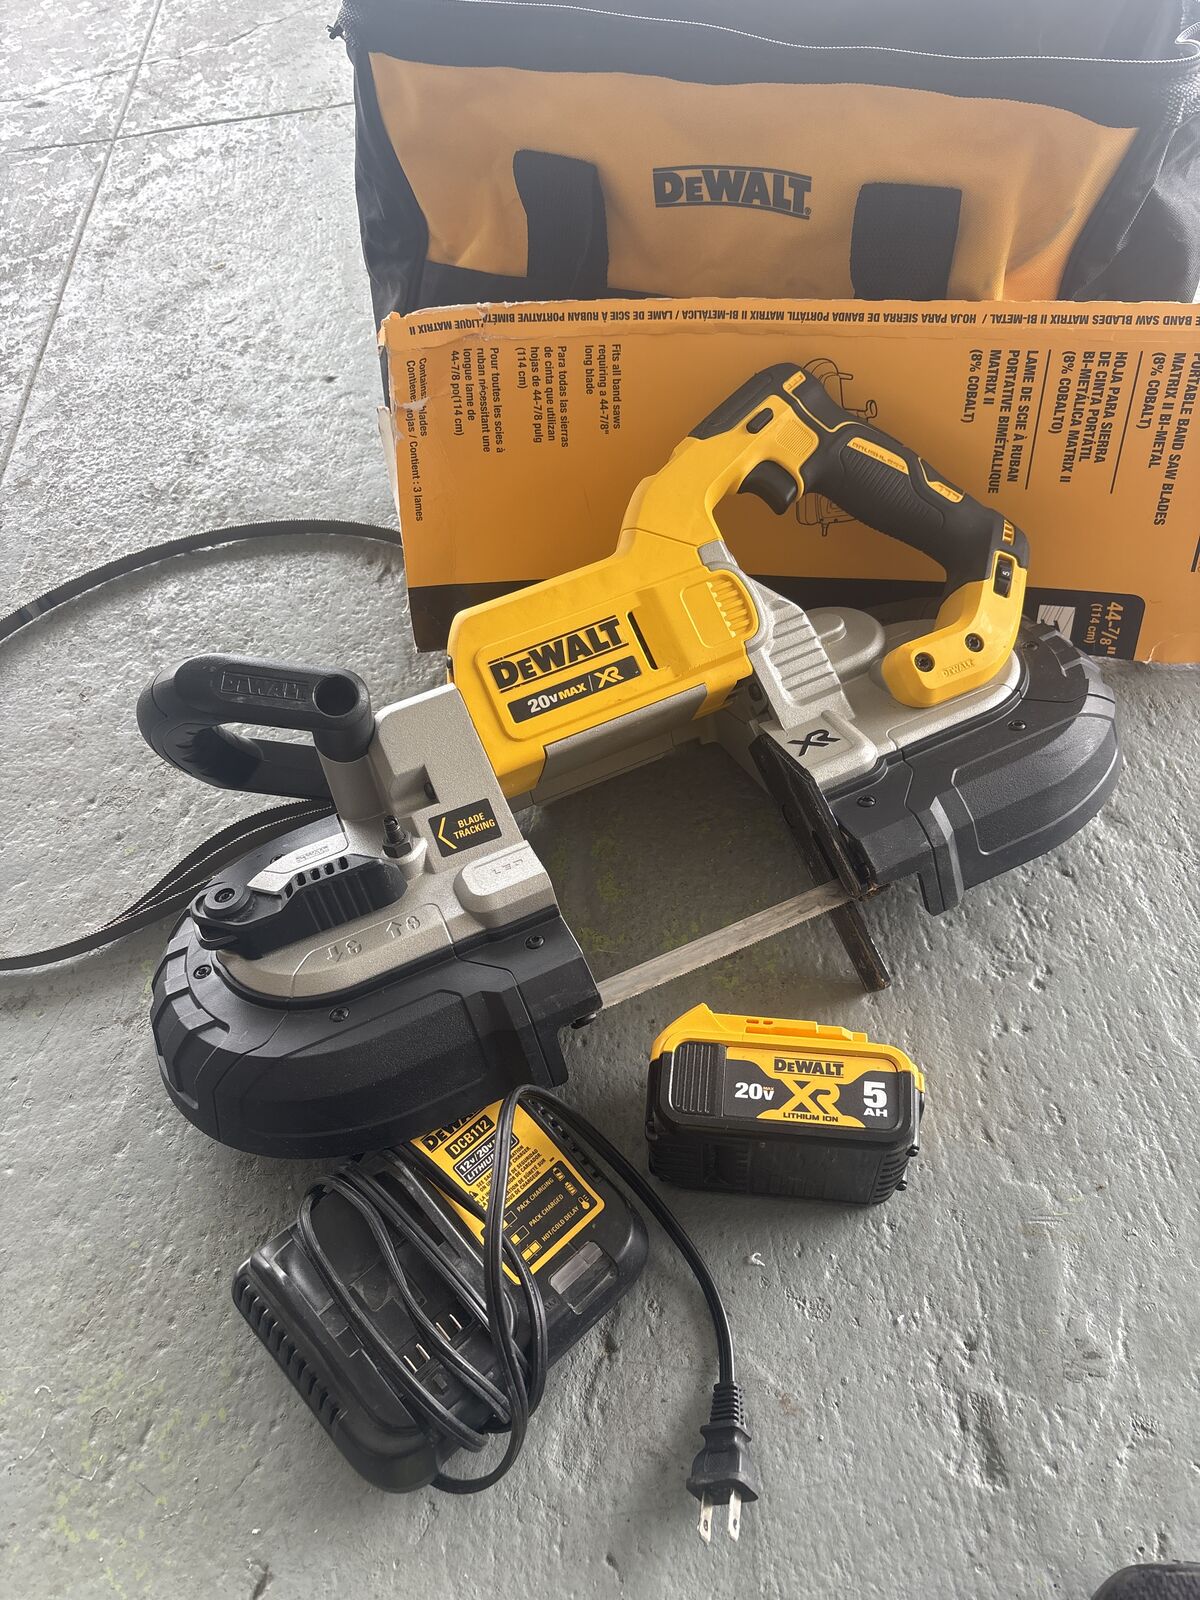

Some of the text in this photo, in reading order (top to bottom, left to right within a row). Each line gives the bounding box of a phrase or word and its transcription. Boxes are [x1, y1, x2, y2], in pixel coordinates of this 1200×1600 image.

[654, 169, 811, 217] DEWALT
[417, 321, 452, 334] MATRIX
[518, 312, 565, 322] PORTATIVE
[568, 312, 599, 321] RUBAN
[601, 312, 608, 323] À
[610, 311, 630, 320] SCIE
[633, 311, 645, 320] DE
[648, 310, 672, 320] LAME
[682, 310, 739, 322] BI-METÁLICA
[741, 310, 747, 320] II
[750, 311, 784, 320] MATRIX
[787, 311, 829, 323] PORTÁTIL
[832, 312, 865, 322] BANDA
[867, 313, 880, 322] DE
[883, 313, 918, 323] SIERRA
[921, 314, 947, 323] PARA
[950, 314, 976, 324] HOJA
[990, 314, 1038, 324] BI-METAL
[1040, 314, 1047, 324] II
[1050, 314, 1089, 324] MATRIX
[1092, 315, 1133, 325] BLADES
[1135, 315, 1160, 325] SAW
[1163, 316, 1192, 326] BAND
[409, 326, 416, 335] II
[451, 350, 460, 381] 44-7/8
[490, 348, 499, 370] Pour
[597, 344, 608, 388] requiring
[612, 344, 621, 362] Fits
[406, 360, 417, 402] Contiene:
[515, 347, 528, 389] (114 cm)
[583, 345, 595, 395] long blade
[612, 364, 621, 376] all
[984, 350, 1002, 394] MATRIX
[462, 348, 476, 421] longue lame de
[492, 372, 501, 402] toutes
[529, 347, 544, 443] hojas de 44-7/8 pulg
[544, 346, 556, 441] de cinta que utilizan
[558, 346, 570, 447] Para todas las sierras
[612, 378, 622, 402] band
[960, 349, 983, 423] (8% COBALT)
[1048, 351, 1076, 434] (8% COBALTO)
[1070, 351, 1095, 427] BI-METÁLICA
[1136, 352, 1167, 429] (8% COBALT)
[477, 348, 491, 452] ruban nécessitant une
[493, 405, 502, 419] les
[1078, 351, 1112, 462] DE CINTA PORTÁTIL
[1094, 352, 1128, 463] HOJA PARA SIERRA
[1148, 353, 1186, 468] MATRIX II BI-METAL
[453, 418, 464, 436] cm)
[600, 399, 609, 434] 44-7/8"
[987, 350, 1020, 494] PORTATIVE BIMÉTALLIQUE
[1007, 350, 1039, 482] LAME DE SCIE À RUBAN
[494, 421, 504, 445] scies
[1172, 418, 1190, 450] BAND
[409, 441, 420, 479] Contient
[1061, 430, 1080, 473] MATRIX
[1164, 454, 1181, 480] SAW
[414, 495, 423, 521] lames
[1153, 483, 1174, 525] BLADES
[1084, 603, 1103, 643] (114 cm)
[1100, 602, 1123, 654] 44-7/8"
[489, 618, 624, 690] DEWALT
[594, 666, 624, 688] XR
[787, 729, 841, 757] XR
[453, 819, 495, 839] TRACKING
[458, 812, 485, 828] BLADE
[774, 1058, 844, 1076] DEWALT
[778, 1078, 842, 1115] XR
[863, 1081, 887, 1108] 5
[783, 1112, 819, 1121] LITHIUM
[863, 1108, 887, 1117] AH
[450, 1120, 490, 1155] DCB112
[516, 1148, 538, 1169] SEGURIDAD
[516, 1199, 531, 1212] PACK
[529, 1178, 554, 1201] CHARGING
[529, 1194, 564, 1227] PACK CHARGED
[541, 1206, 579, 1242] HOT/COLD DELAY
